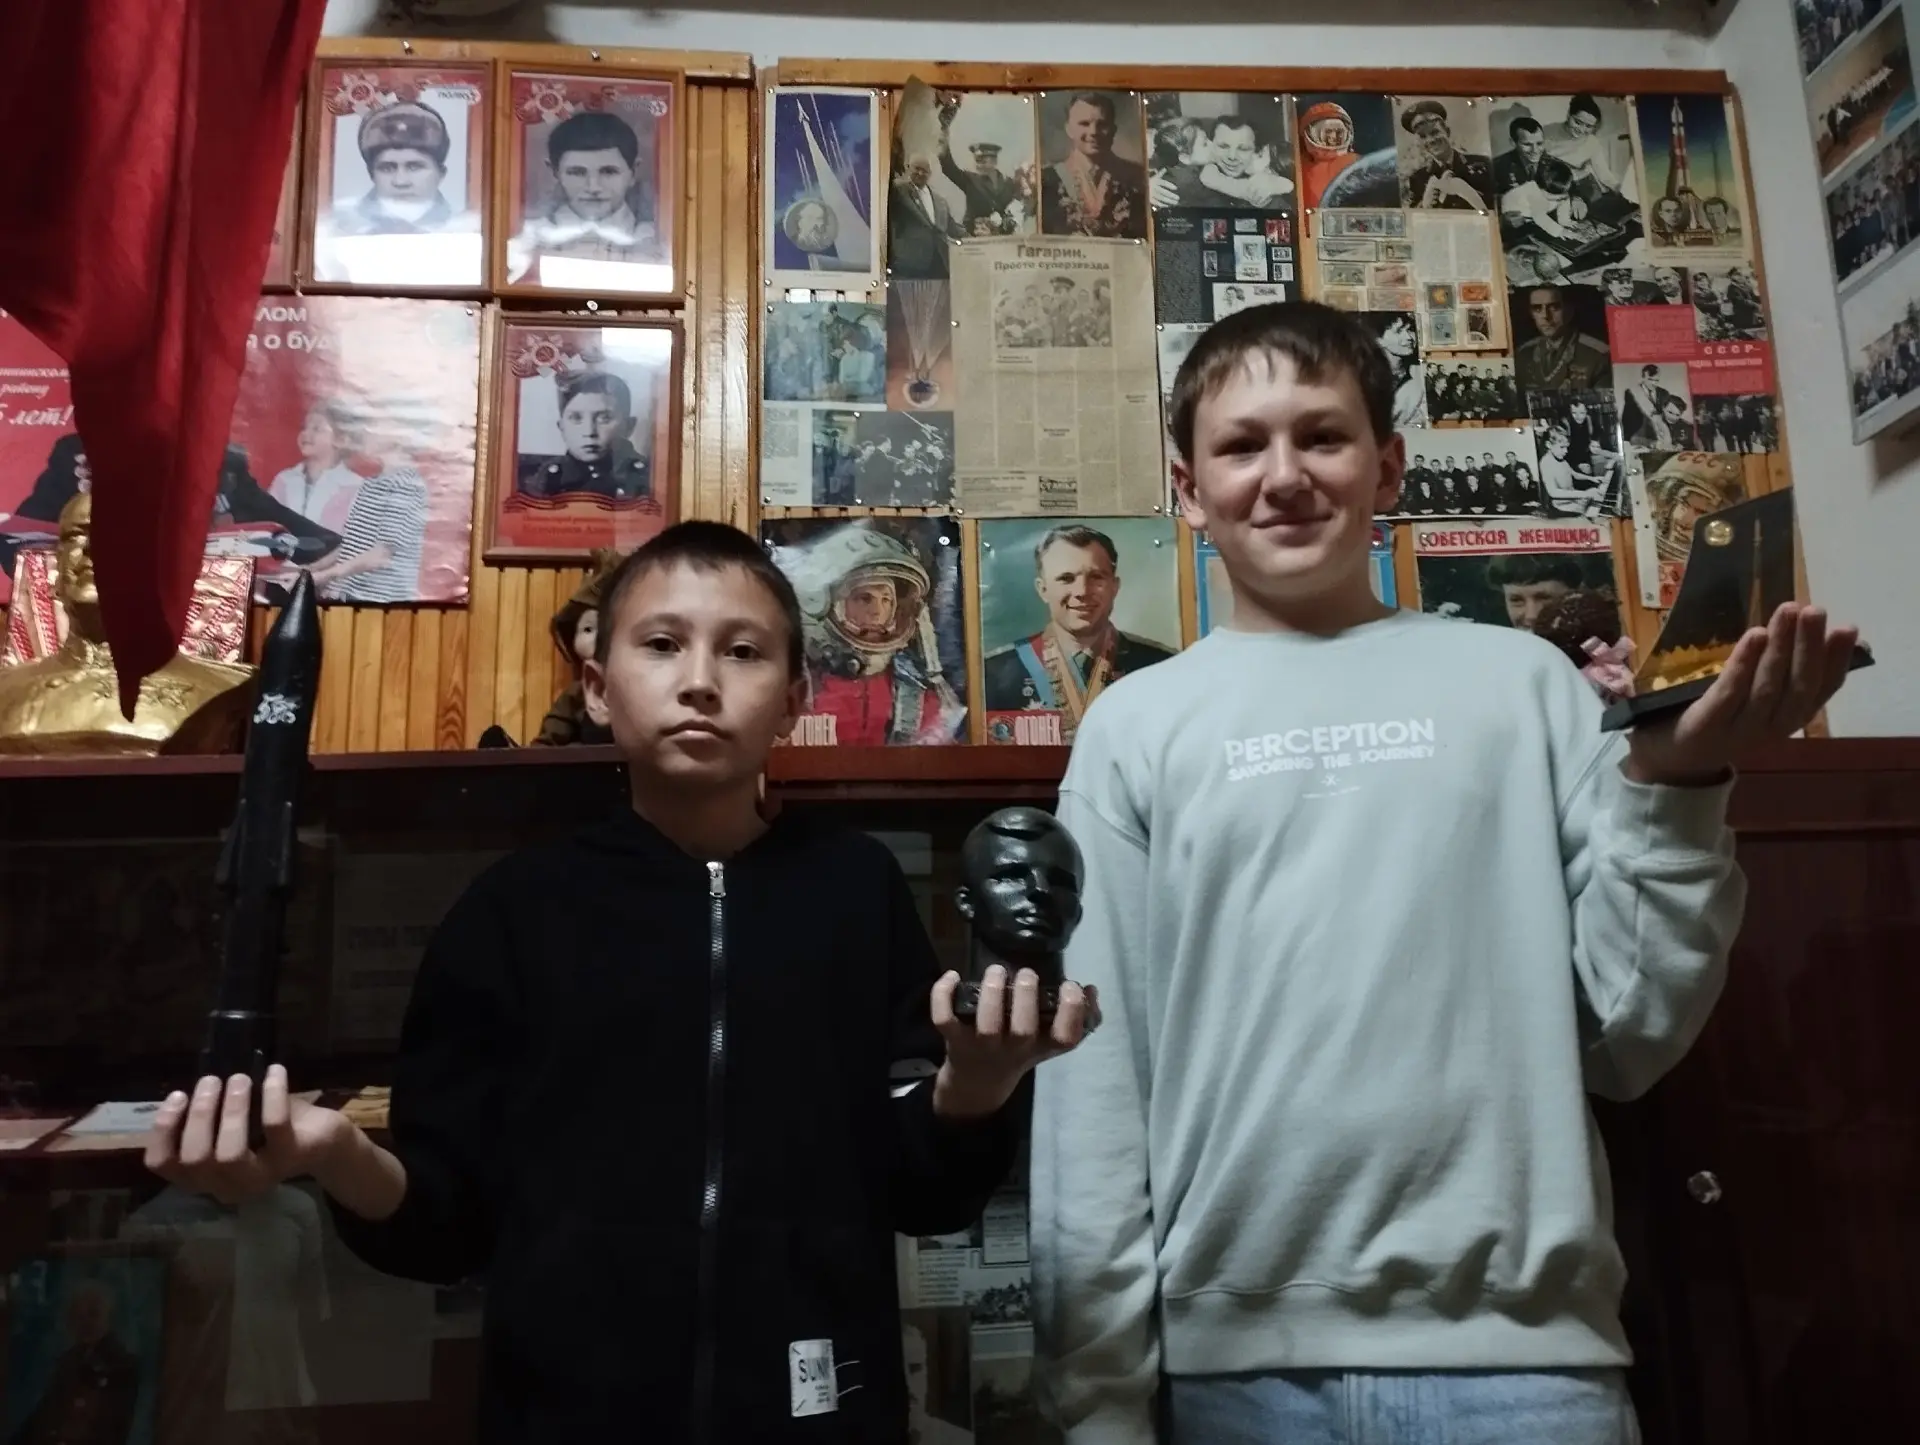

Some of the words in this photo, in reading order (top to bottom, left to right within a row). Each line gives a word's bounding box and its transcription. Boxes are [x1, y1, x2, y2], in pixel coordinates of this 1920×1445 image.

[1017, 244, 1087, 260] Гагарин.
[994, 261, 1036, 271] Просто
[256, 307, 307, 322] лом
[264, 334, 281, 350] о
[1418, 529, 1509, 547] СОВЕТСКАЯ
[1518, 527, 1600, 545] ЖЕНЩИНА
[1224, 717, 1435, 767] PERCEPTION
[1227, 756, 1315, 781] SAVORING
[1321, 753, 1352, 770] THE
[1358, 744, 1436, 764] JOURNEY
